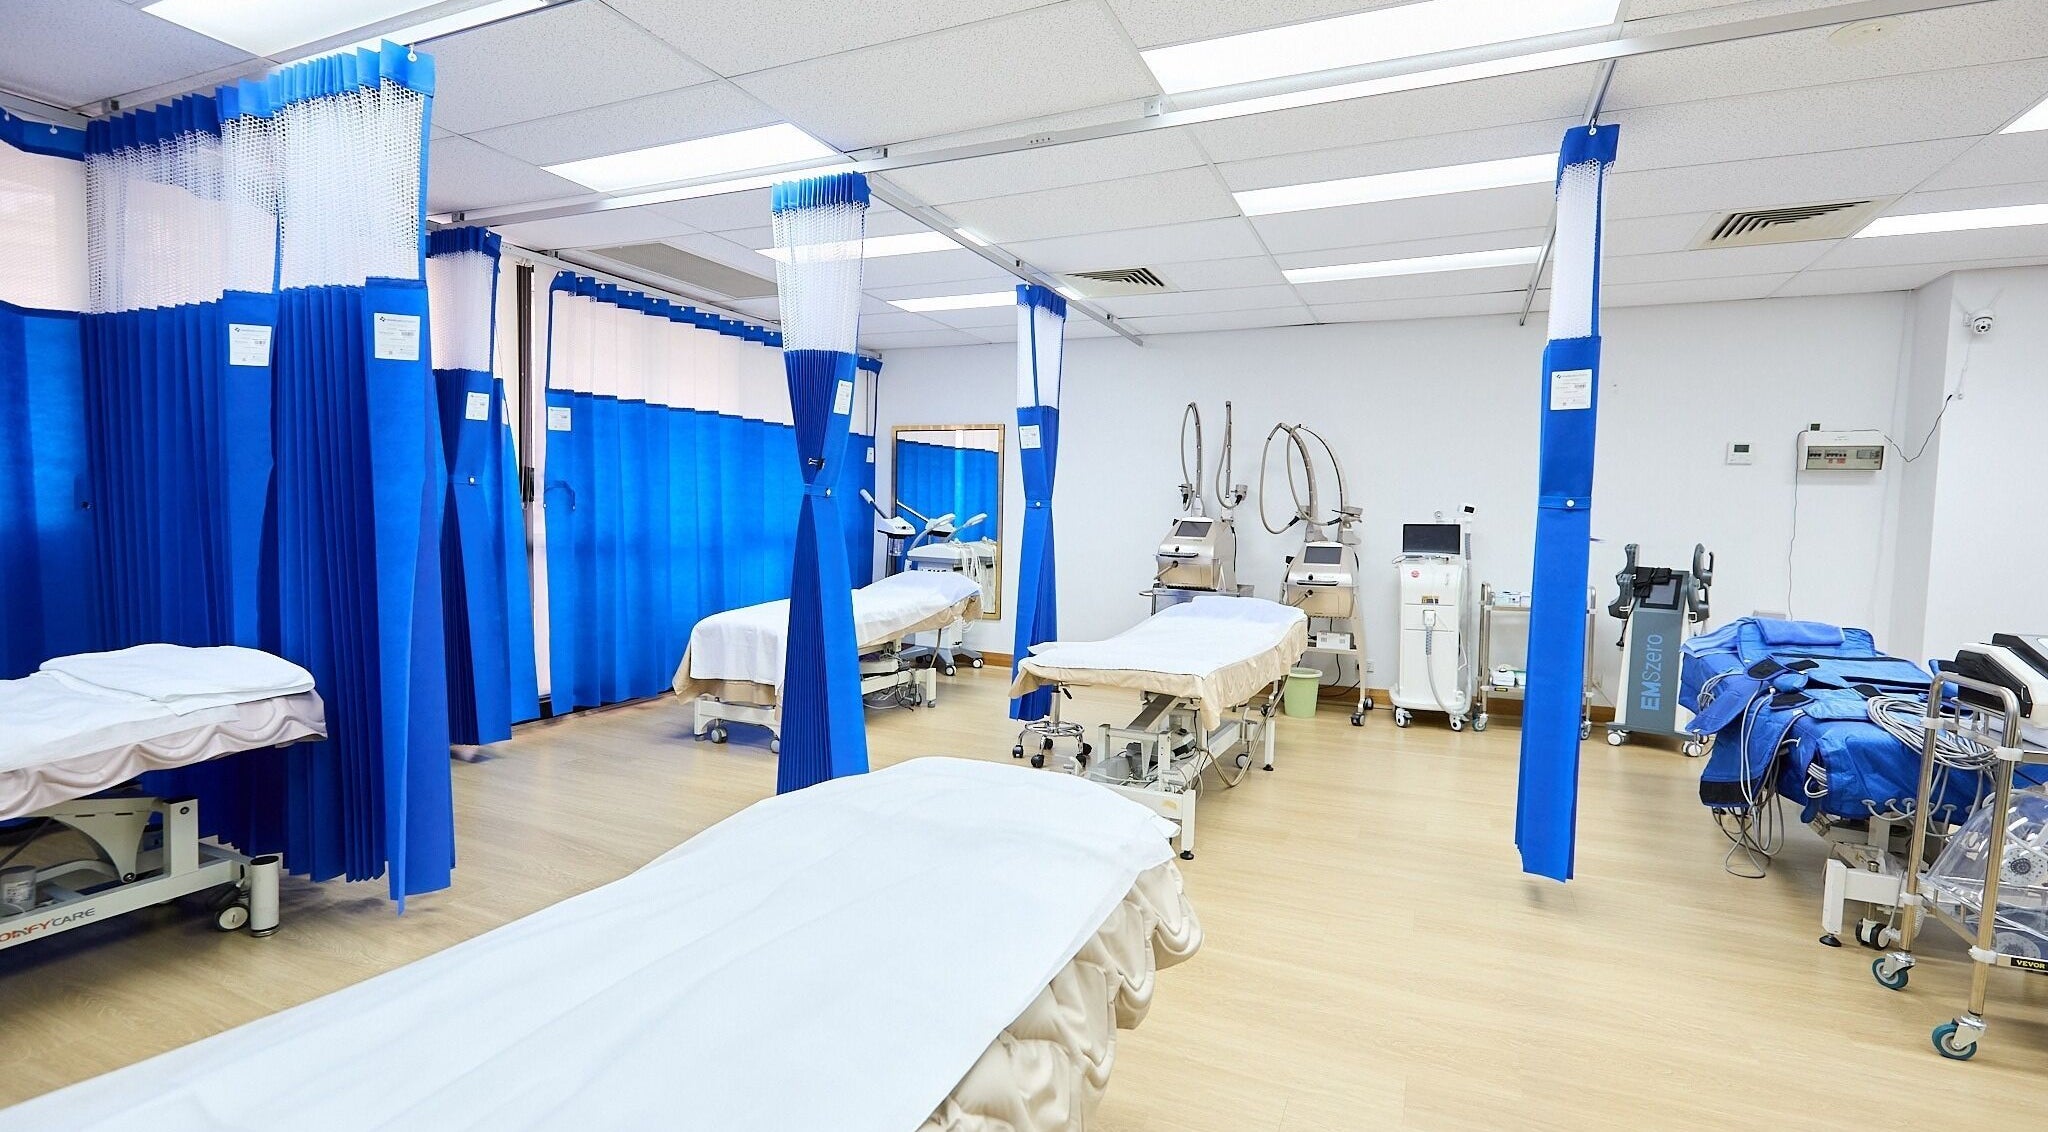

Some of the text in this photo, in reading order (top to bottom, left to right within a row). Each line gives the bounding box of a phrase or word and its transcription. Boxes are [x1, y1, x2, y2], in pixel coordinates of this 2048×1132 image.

[1640, 634, 1663, 711] EMSzero
[0, 907, 96, 943] OMFYCARE
[2016, 959, 2046, 969] VEVOR
